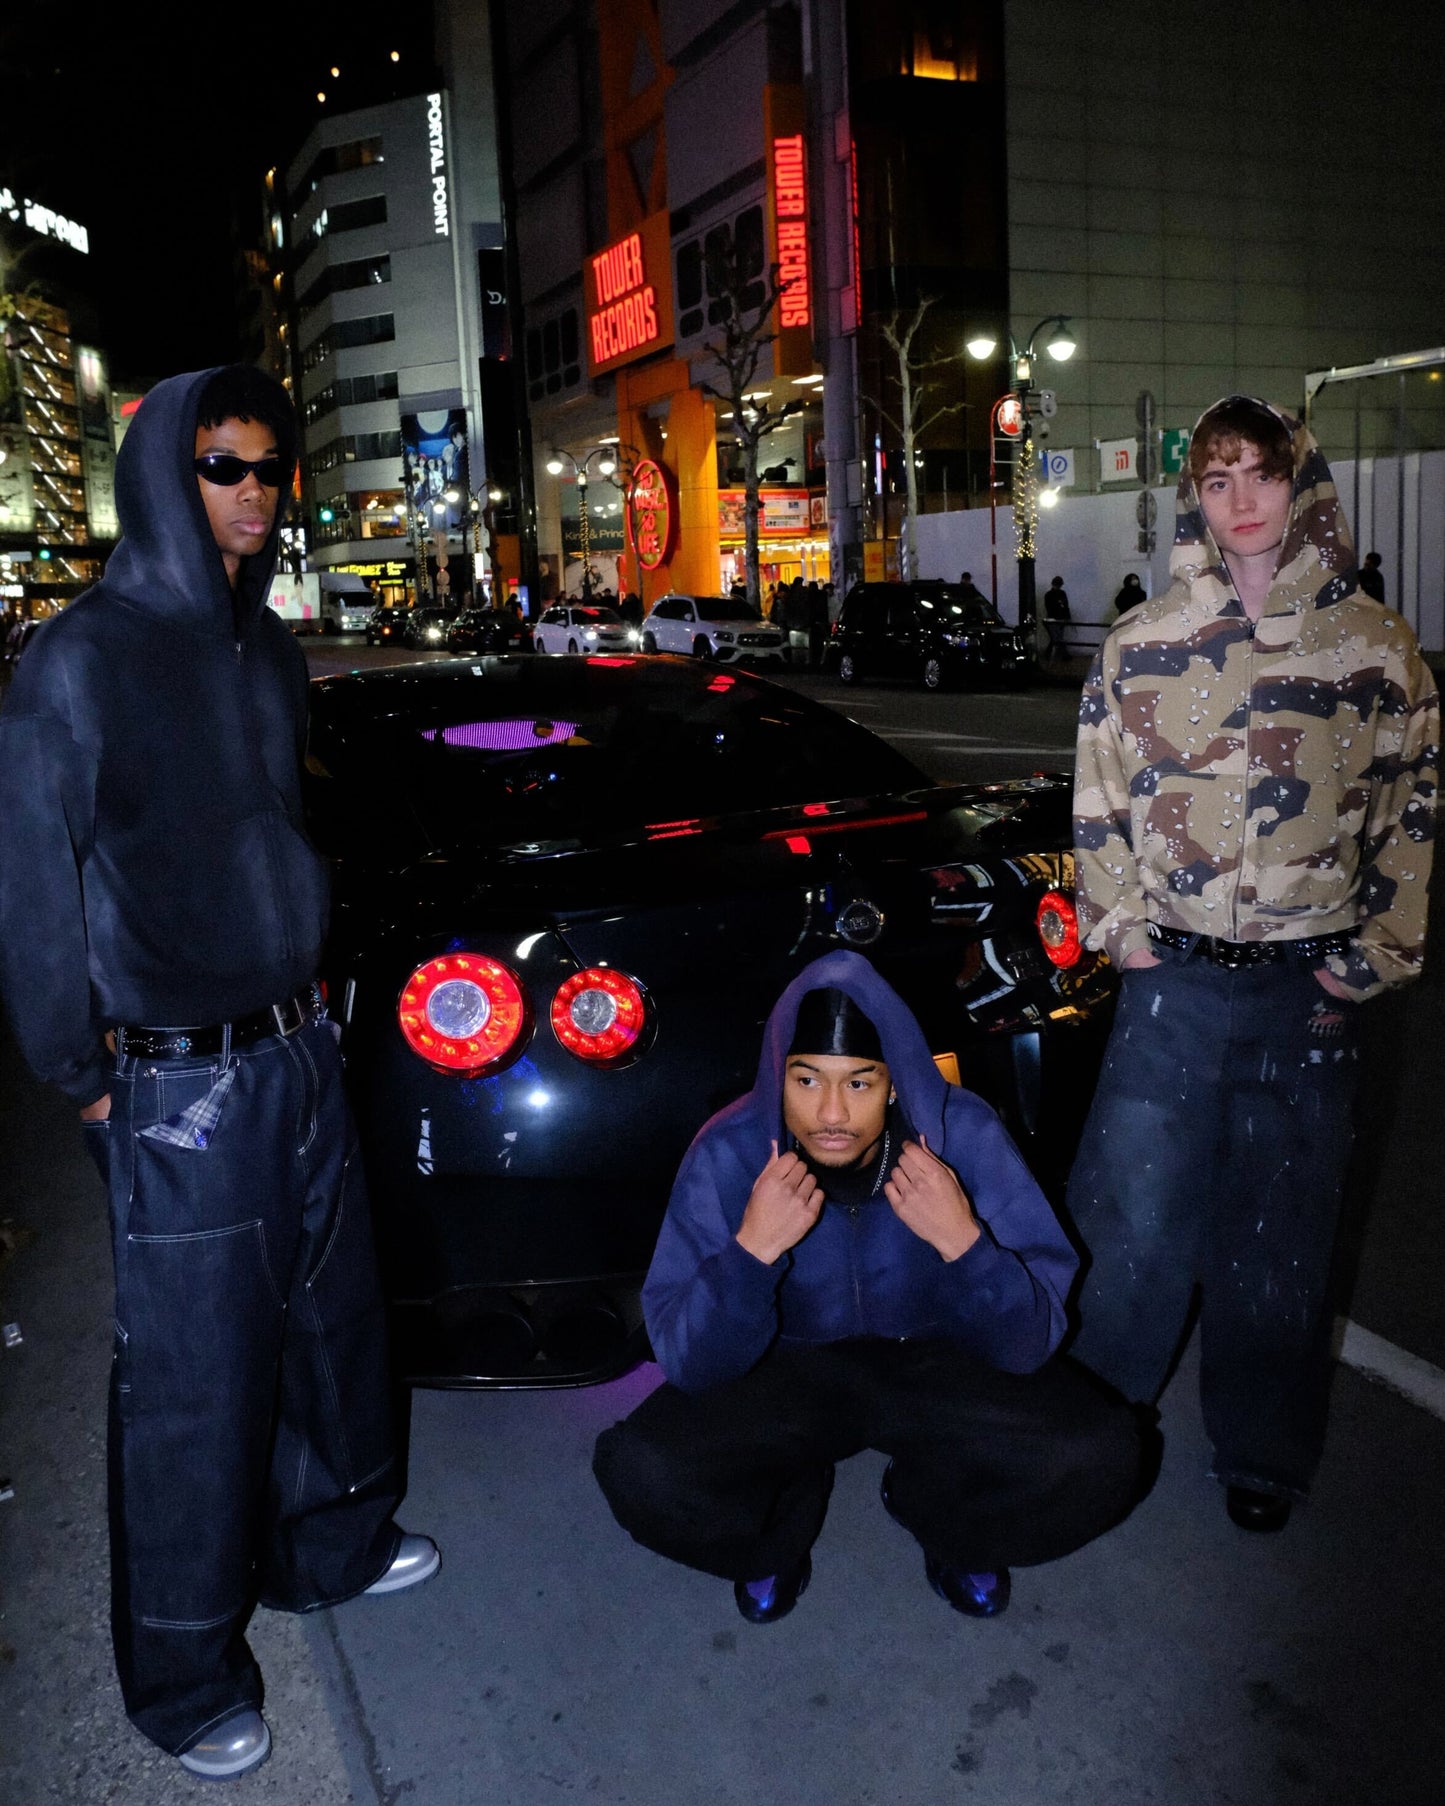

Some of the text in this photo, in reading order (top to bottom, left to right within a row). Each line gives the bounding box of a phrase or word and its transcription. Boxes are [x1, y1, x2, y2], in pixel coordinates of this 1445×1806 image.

[427, 93, 448, 236] PORTAL POINT
[592, 233, 644, 306] TOWER
[774, 134, 809, 327] TOWER RECORDS
[591, 286, 658, 364] RECORDS
